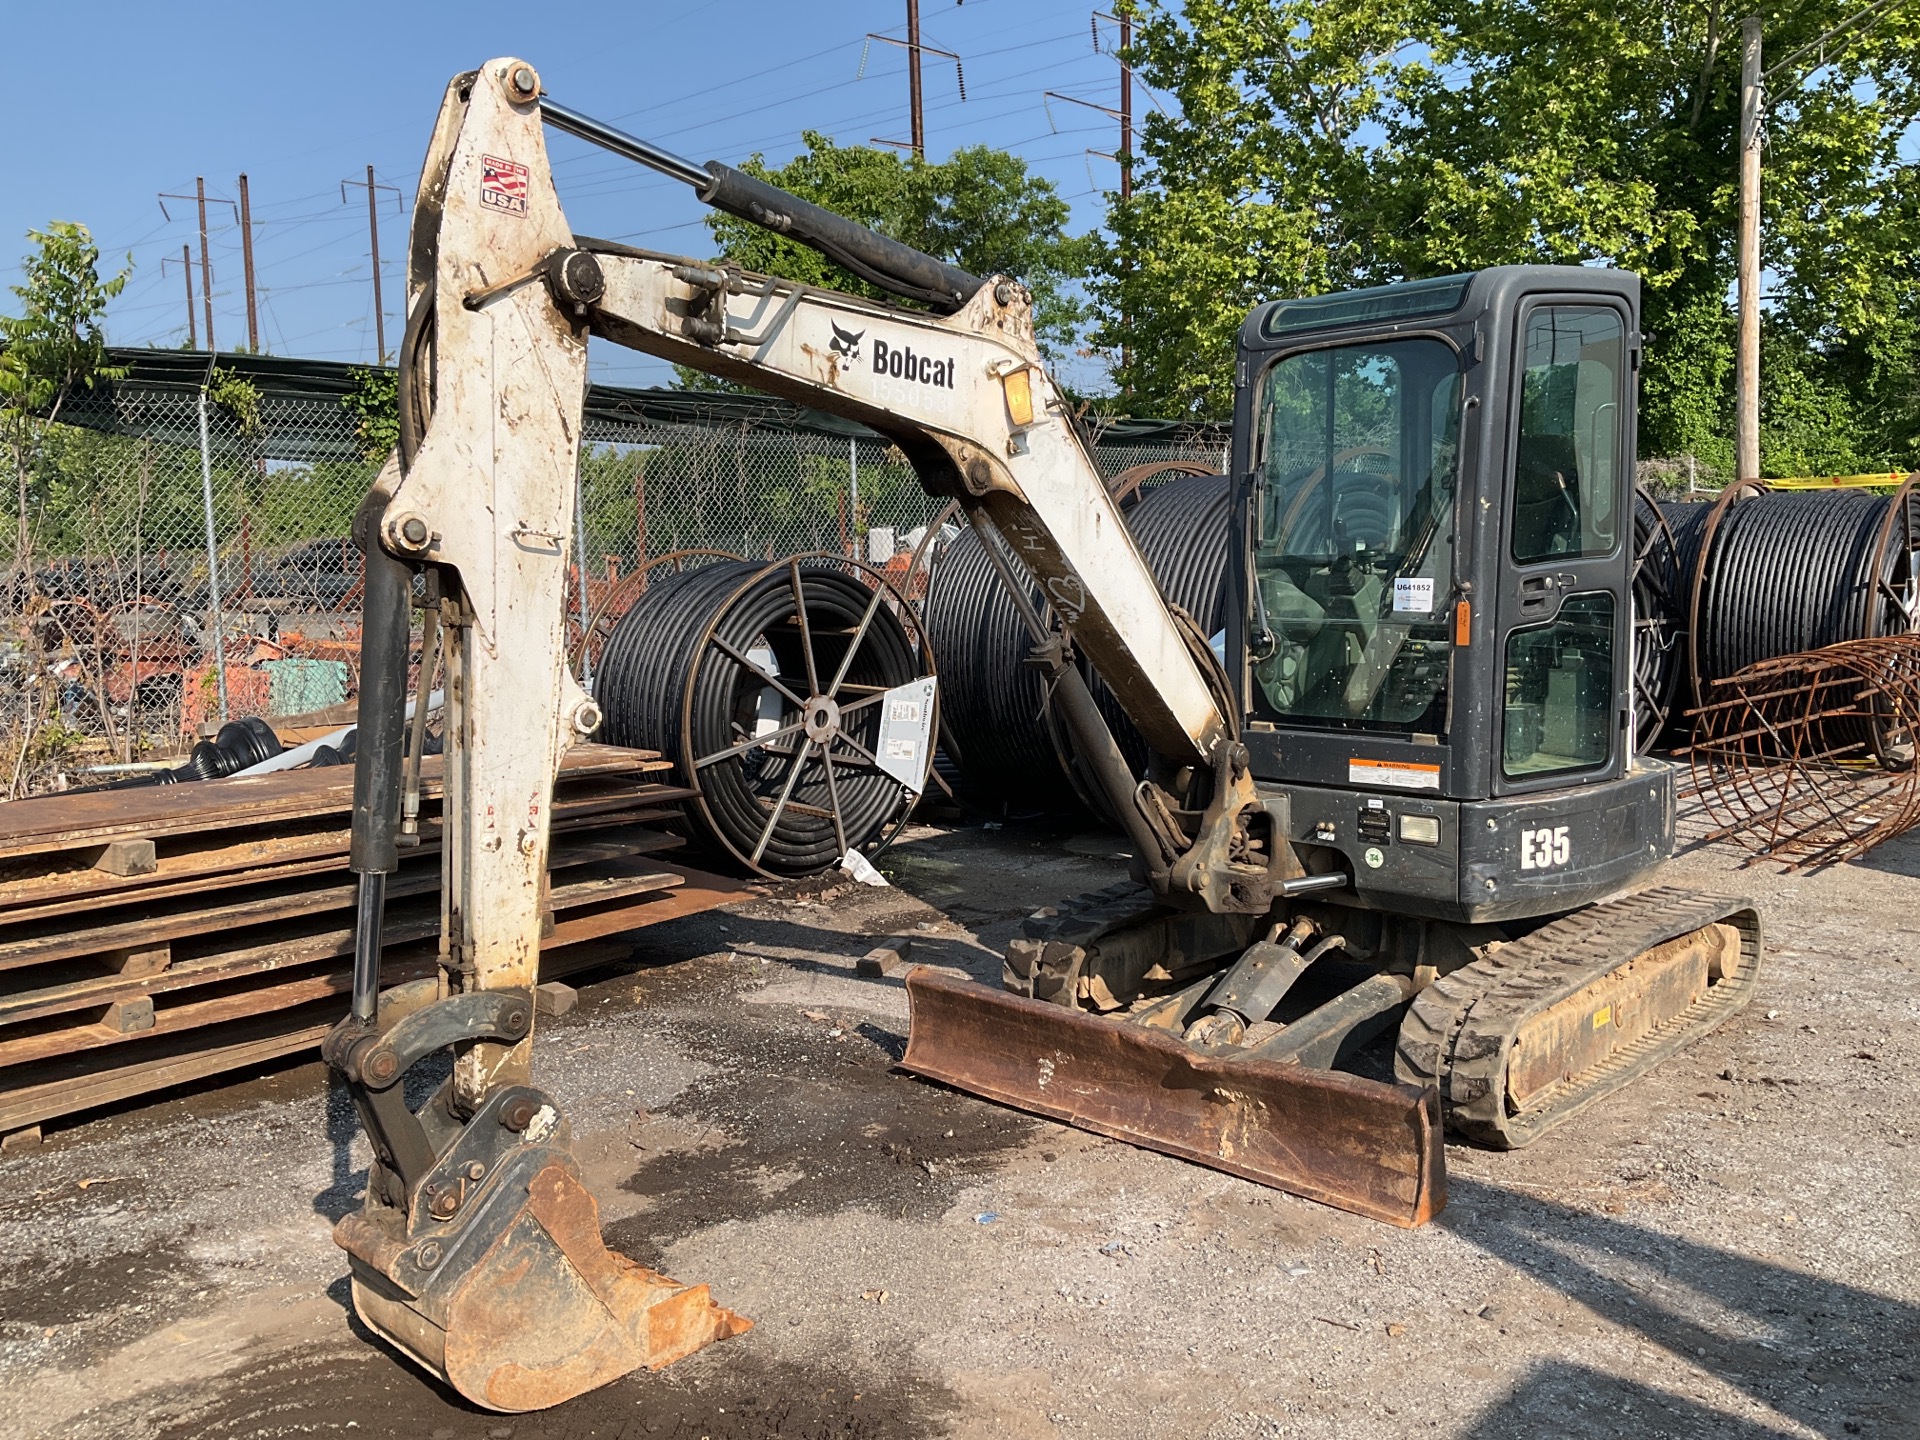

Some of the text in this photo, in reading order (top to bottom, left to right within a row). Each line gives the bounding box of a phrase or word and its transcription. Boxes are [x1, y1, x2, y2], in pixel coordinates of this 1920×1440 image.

[484, 190, 522, 211] USA
[873, 338, 955, 390] Bobcat
[1521, 826, 1570, 869] E35
